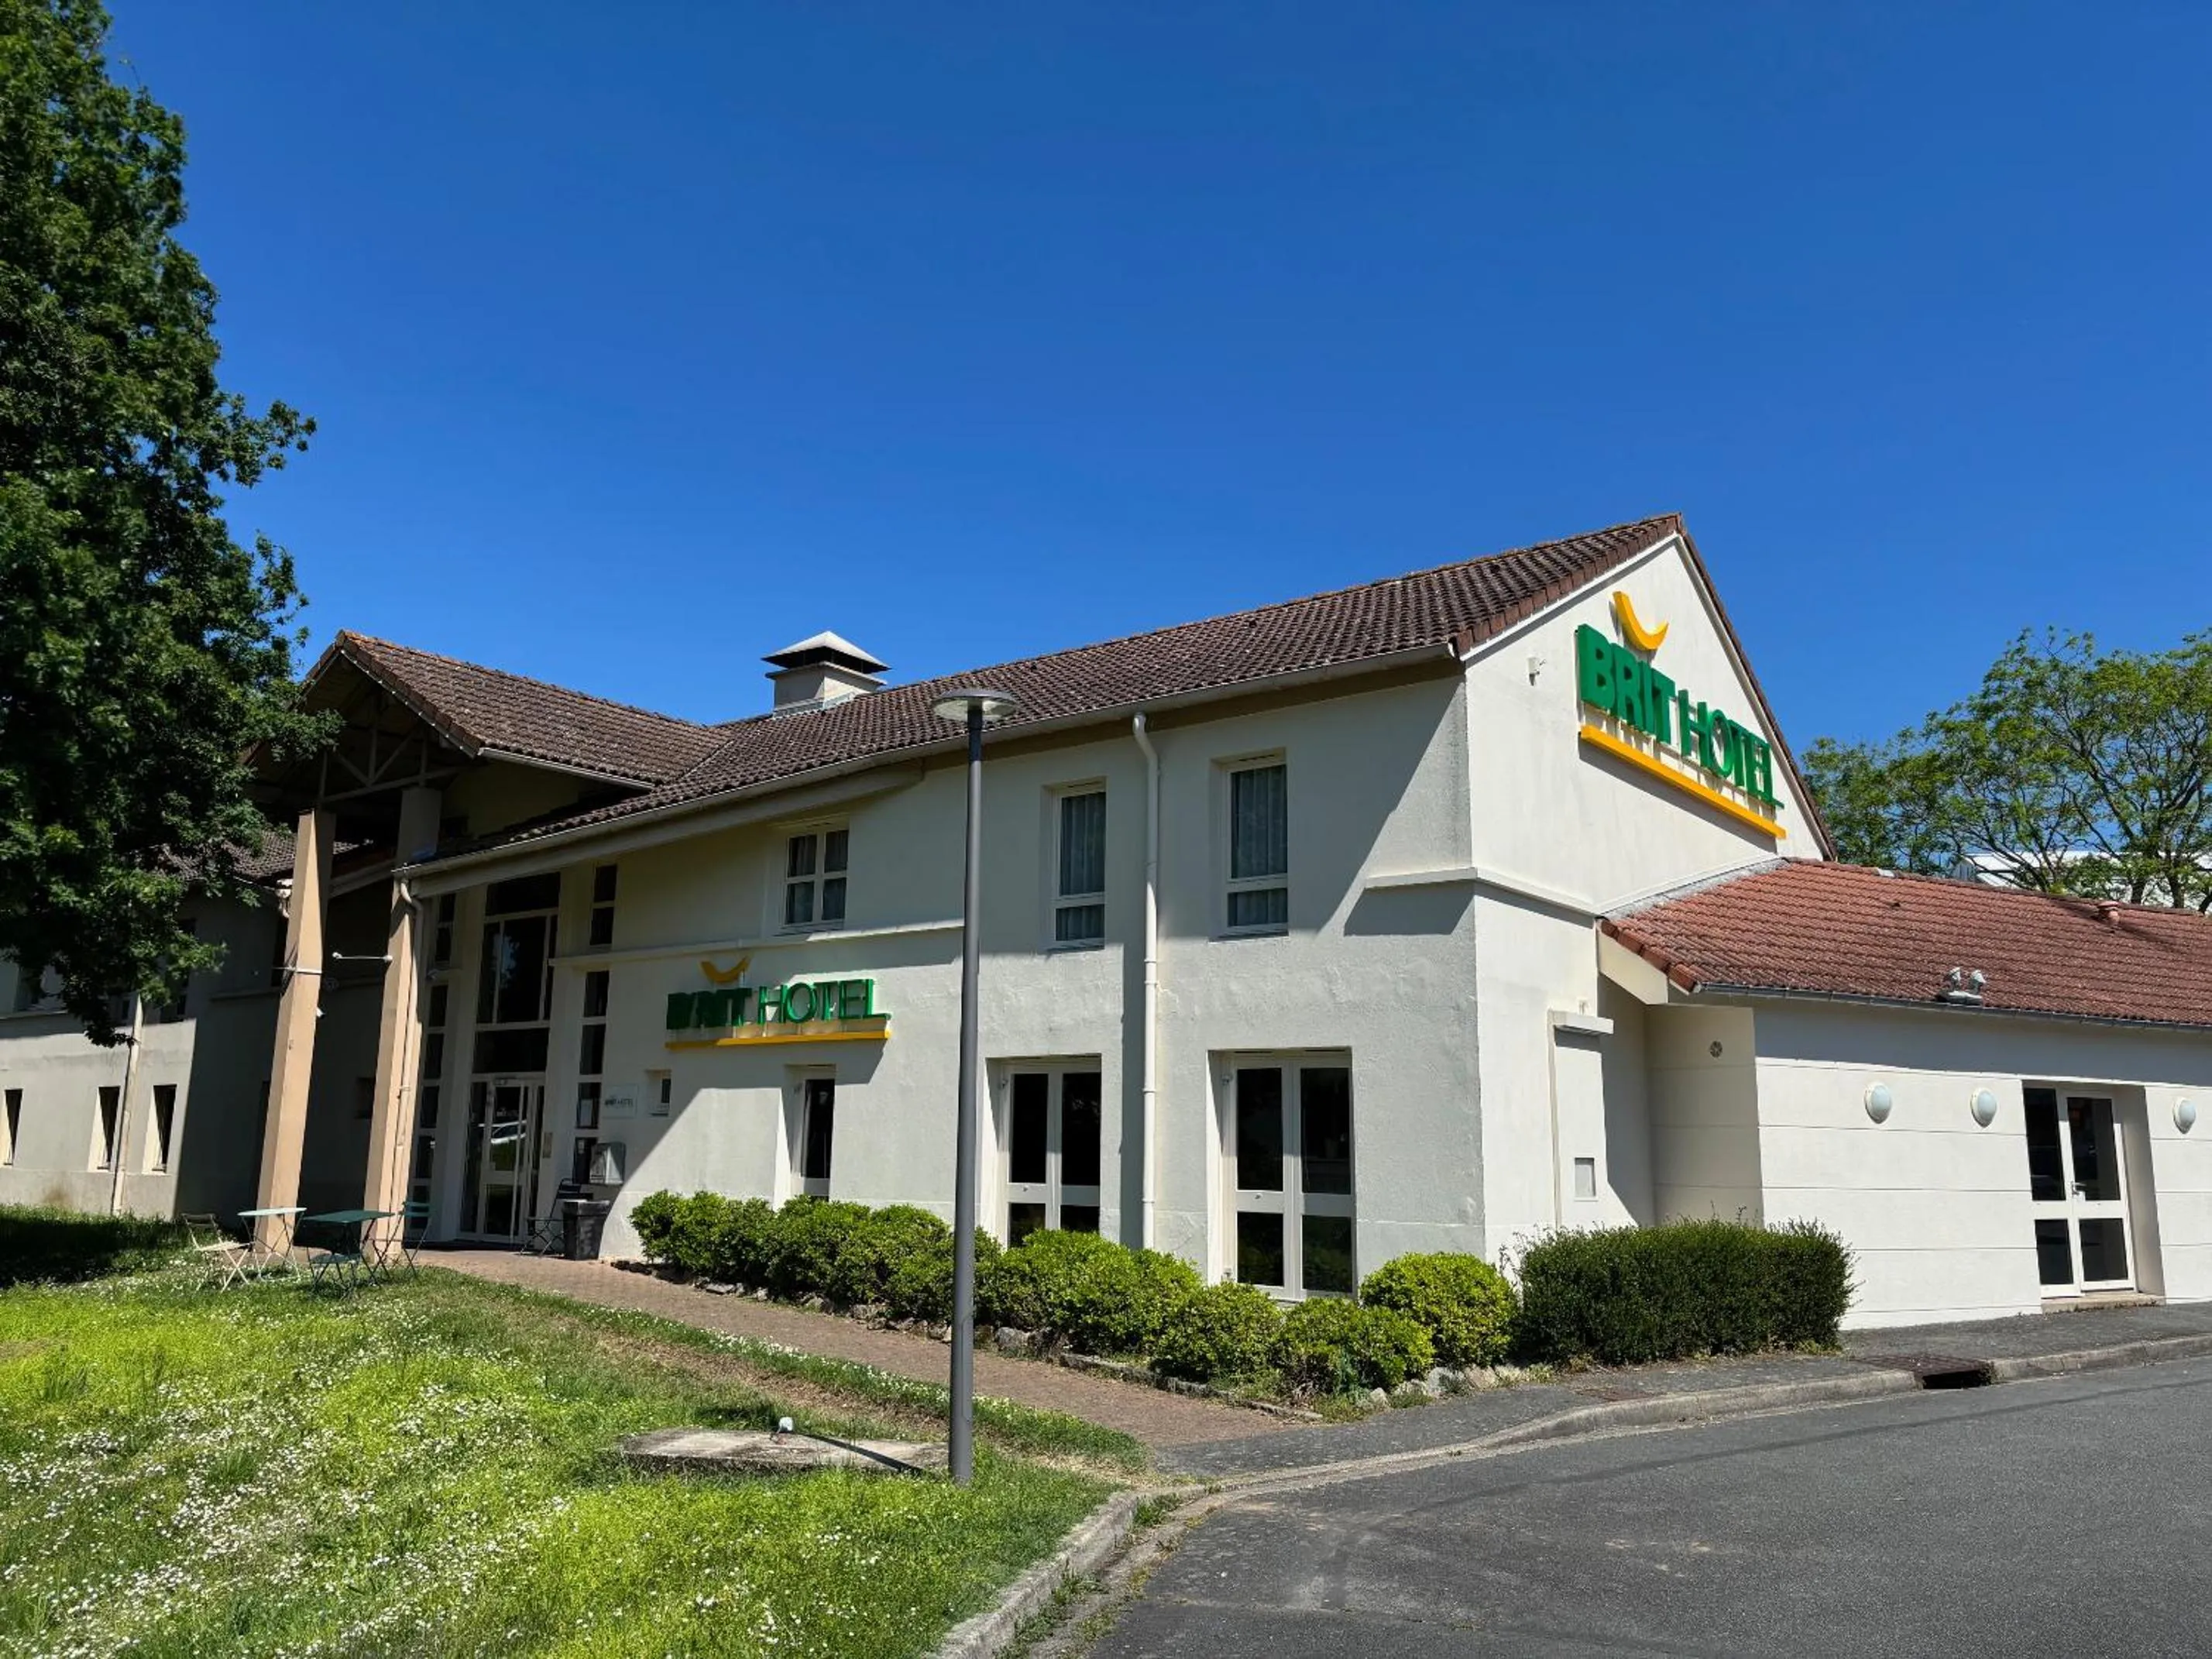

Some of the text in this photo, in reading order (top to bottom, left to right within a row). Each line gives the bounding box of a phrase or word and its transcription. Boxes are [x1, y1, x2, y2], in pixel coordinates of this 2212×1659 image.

[1577, 623, 1784, 809] BRIT HOTEL
[757, 978, 890, 1026] HOTEL
